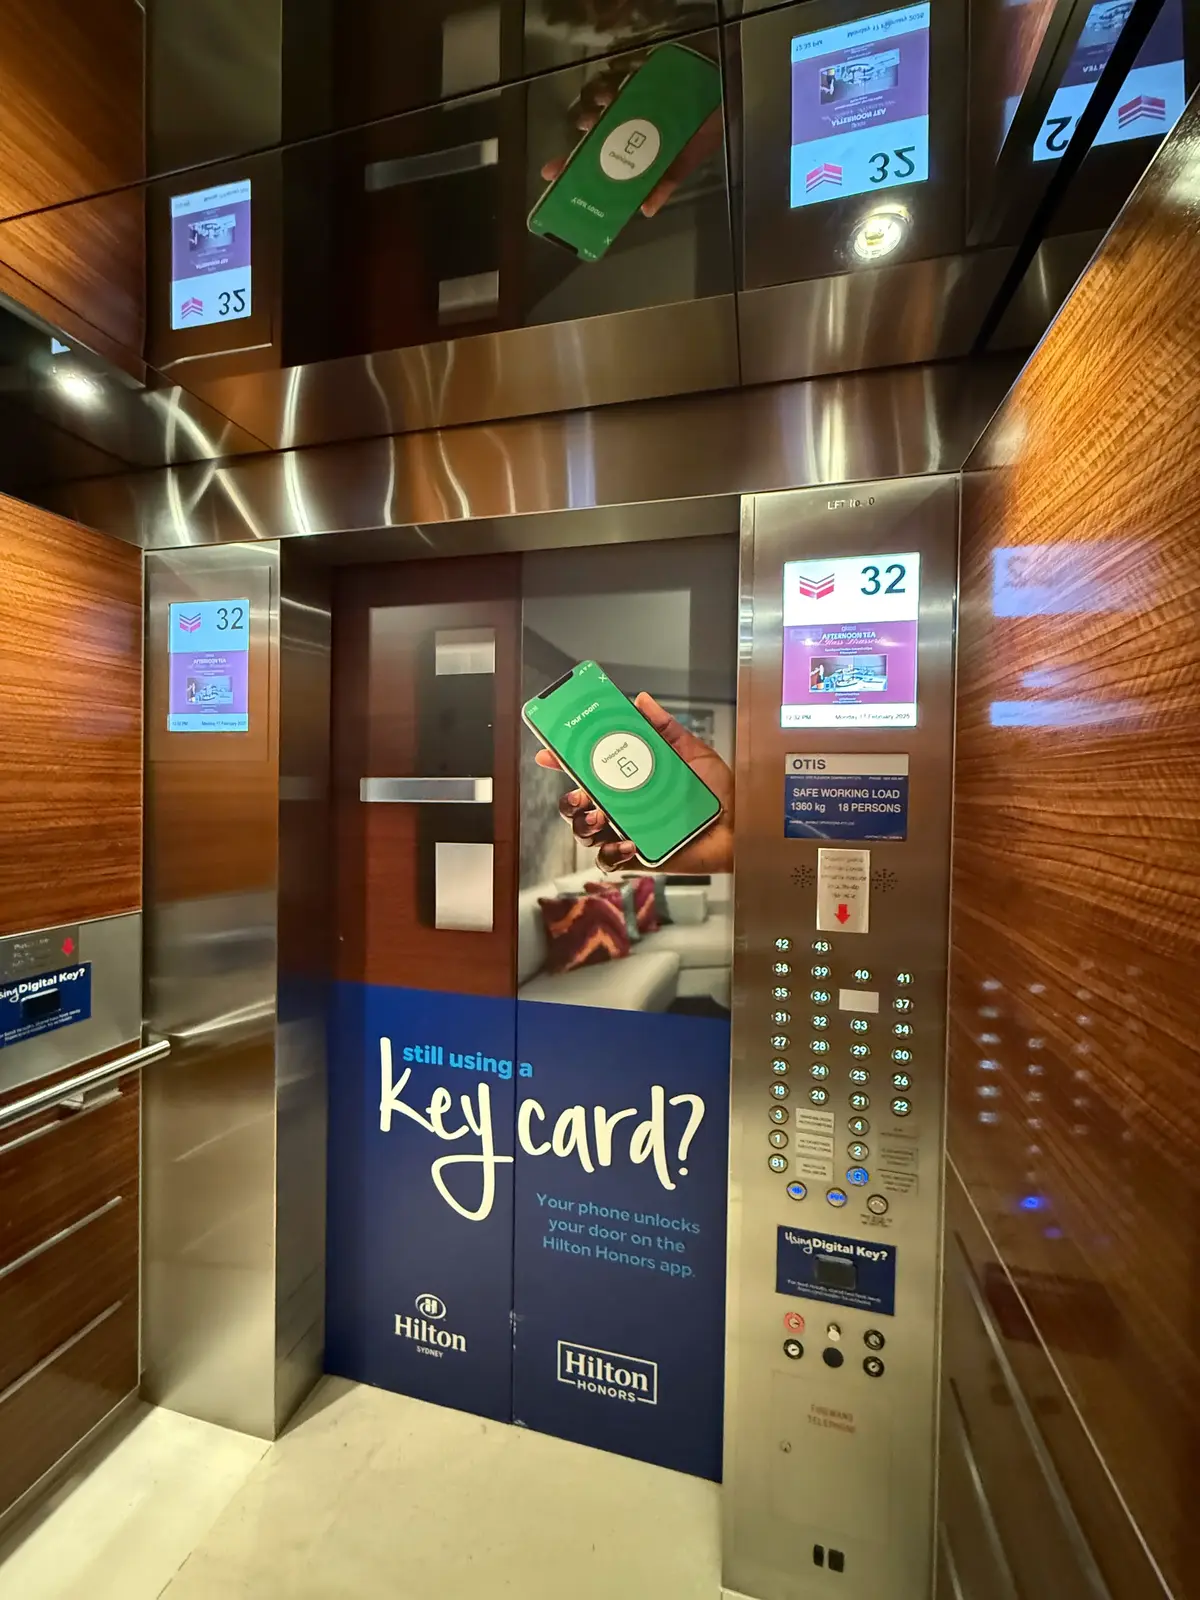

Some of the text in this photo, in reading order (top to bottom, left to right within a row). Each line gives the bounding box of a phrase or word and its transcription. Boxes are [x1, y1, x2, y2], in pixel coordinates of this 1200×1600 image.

[860, 564, 906, 596] 32
[216, 607, 244, 630] 32
[821, 632, 862, 640] AFTERNOON
[564, 701, 600, 729] Your room
[601, 741, 629, 764] Unlocked!
[792, 758, 826, 770] OTIS
[792, 788, 900, 799] SAFE WORKING LOAD
[791, 802, 826, 813] 1360 kg
[838, 802, 901, 813] 18 PERSONS
[775, 938, 789, 949] 42
[814, 941, 829, 952] 43
[775, 962, 789, 973] 38
[814, 966, 828, 977] 39
[854, 969, 870, 980] 40
[897, 973, 910, 984] 41
[18, 975, 57, 994] Digital
[58, 968, 86, 983] Key?
[774, 987, 788, 998] 35
[814, 991, 828, 1002] 36
[895, 998, 910, 1009] 37
[775, 1012, 787, 1022] 31
[813, 1016, 827, 1027] 32
[853, 1020, 868, 1031] 33
[894, 1024, 909, 1035] 34
[774, 1036, 786, 1046] 27
[812, 1040, 826, 1051] 28
[853, 1045, 867, 1056] 29
[894, 1049, 909, 1061] 30
[402, 1044, 533, 1080] still using a
[773, 1060, 786, 1071] 23
[812, 1065, 826, 1076] 24
[852, 1070, 867, 1081] 25
[894, 1074, 909, 1086] 26
[774, 1085, 785, 1096] 18
[811, 1090, 826, 1100] 20
[852, 1095, 865, 1106] 21
[893, 1100, 908, 1112] 22
[775, 1109, 782, 1120] 3
[854, 1120, 863, 1131] 4
[517, 1084, 706, 1191] card?
[775, 1134, 780, 1143] 1
[854, 1145, 862, 1156] 2
[771, 1158, 784, 1168] B1
[536, 1192, 700, 1234] Your phone unlocks
[548, 1218, 686, 1254] your door on the
[784, 1231, 888, 1261] Using Digital Key?
[543, 1235, 696, 1279] Hilton Honors app.
[394, 1314, 467, 1353] Hilton
[416, 1345, 444, 1359] SYDNEY
[565, 1350, 649, 1392] Hilton
[576, 1379, 636, 1403] HONORS
